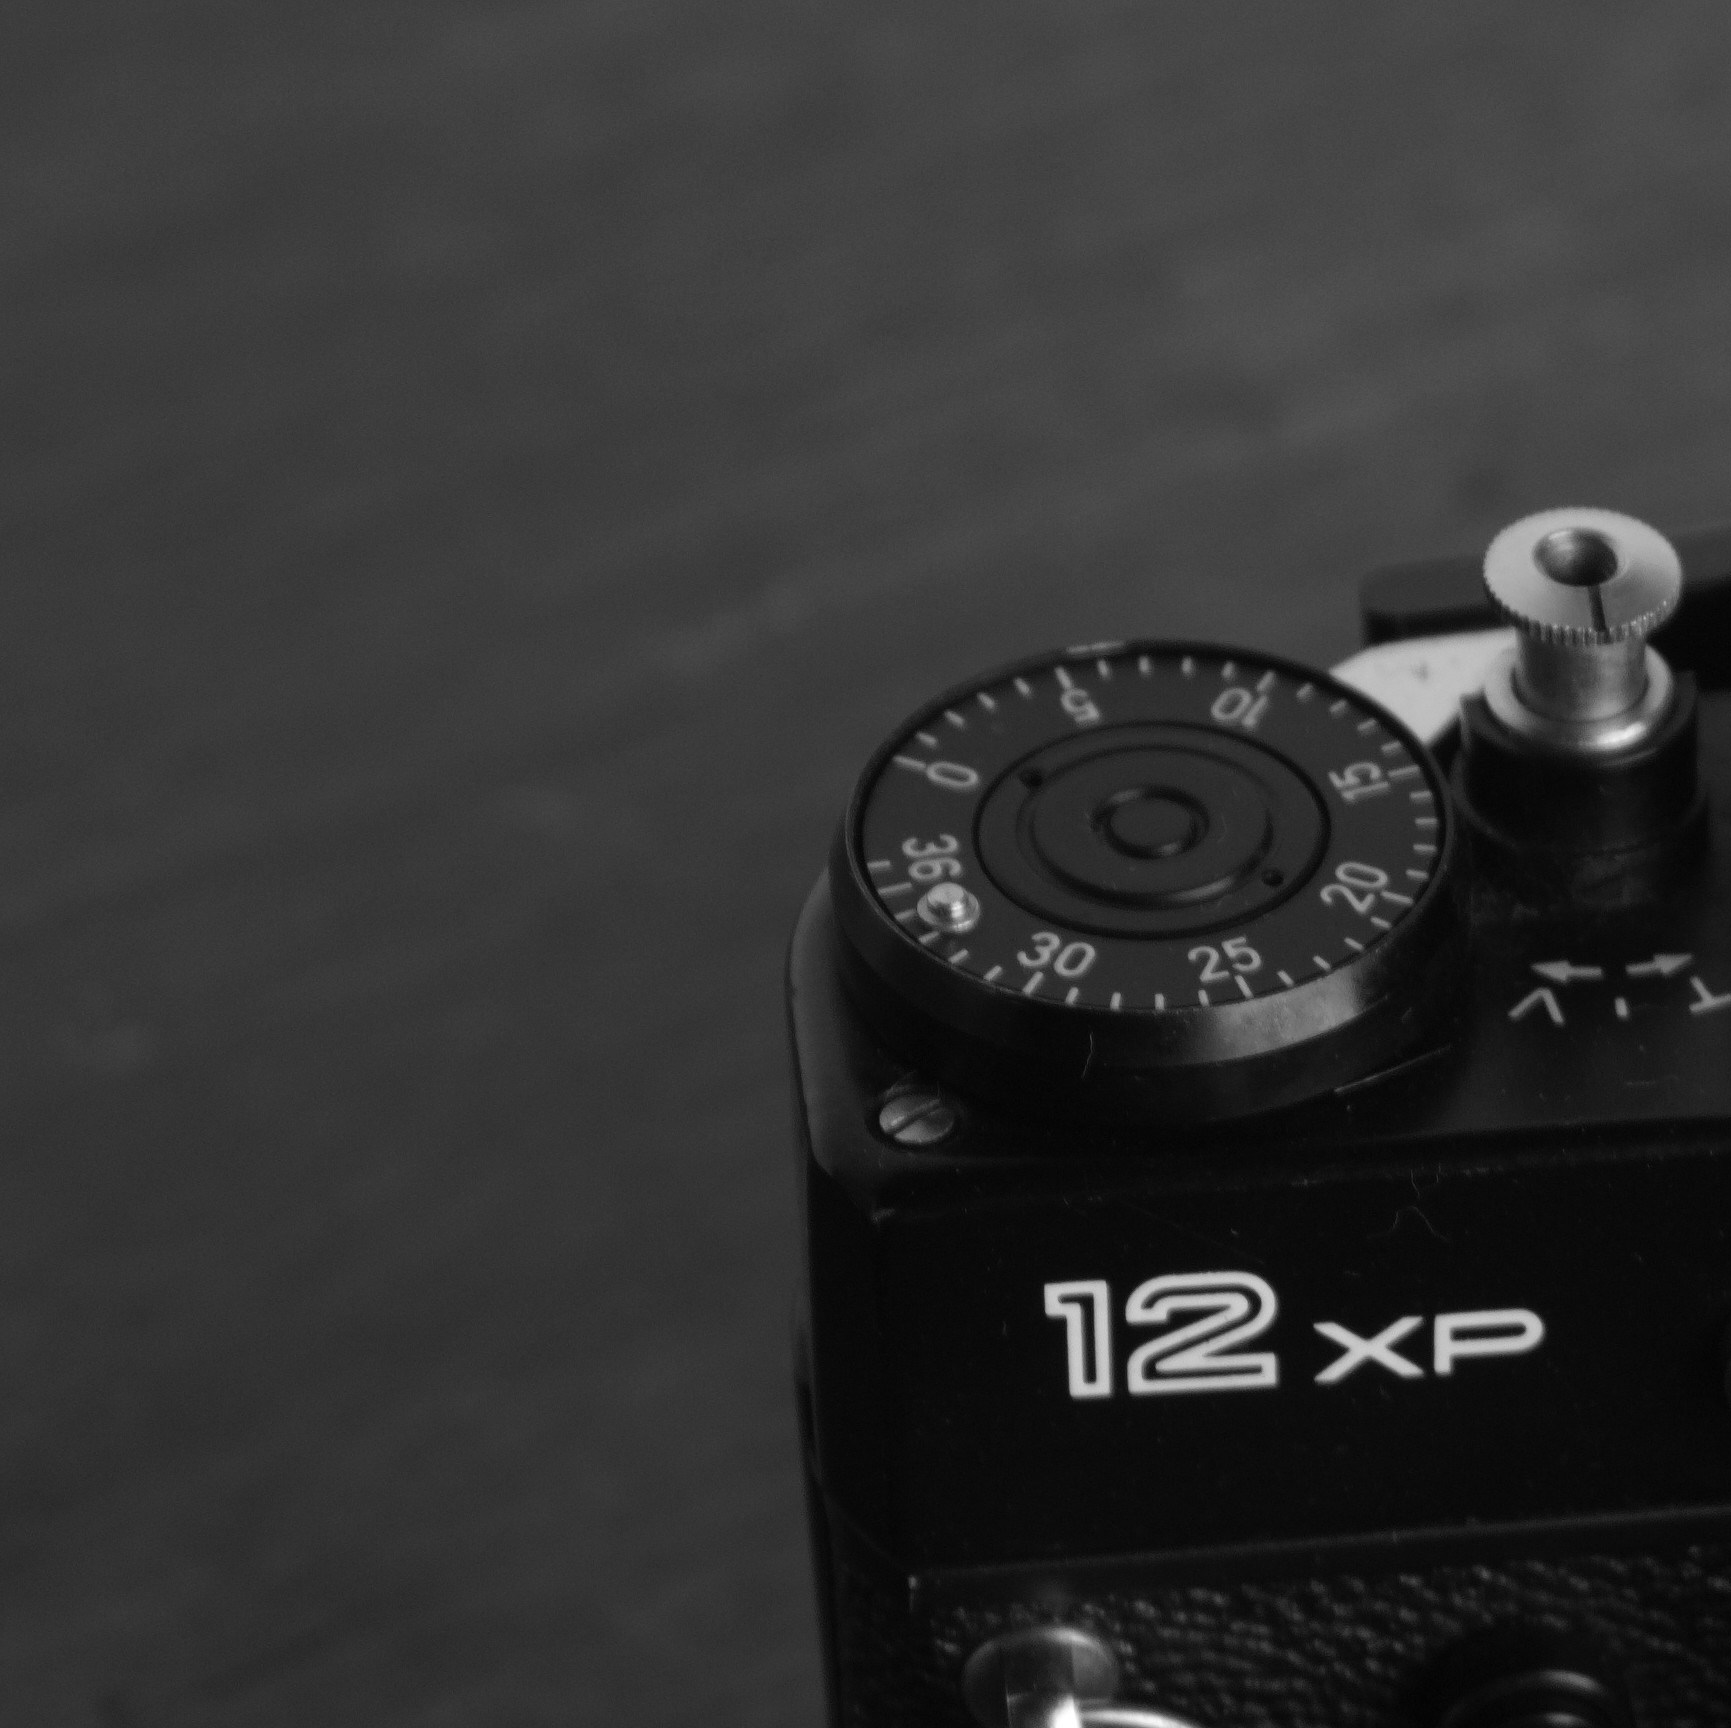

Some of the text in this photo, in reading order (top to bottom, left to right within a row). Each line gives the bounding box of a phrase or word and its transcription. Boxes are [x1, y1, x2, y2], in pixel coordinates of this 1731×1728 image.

[1060, 687, 1102, 724] 5
[1210, 686, 1271, 730] 10
[926, 761, 981, 791] 0
[1328, 761, 1391, 802] 15
[901, 833, 963, 882] 36
[1319, 861, 1390, 914] 20
[1016, 931, 1097, 978] 30
[1187, 936, 1262, 983] 25
[1042, 1270, 1279, 1400] 12
